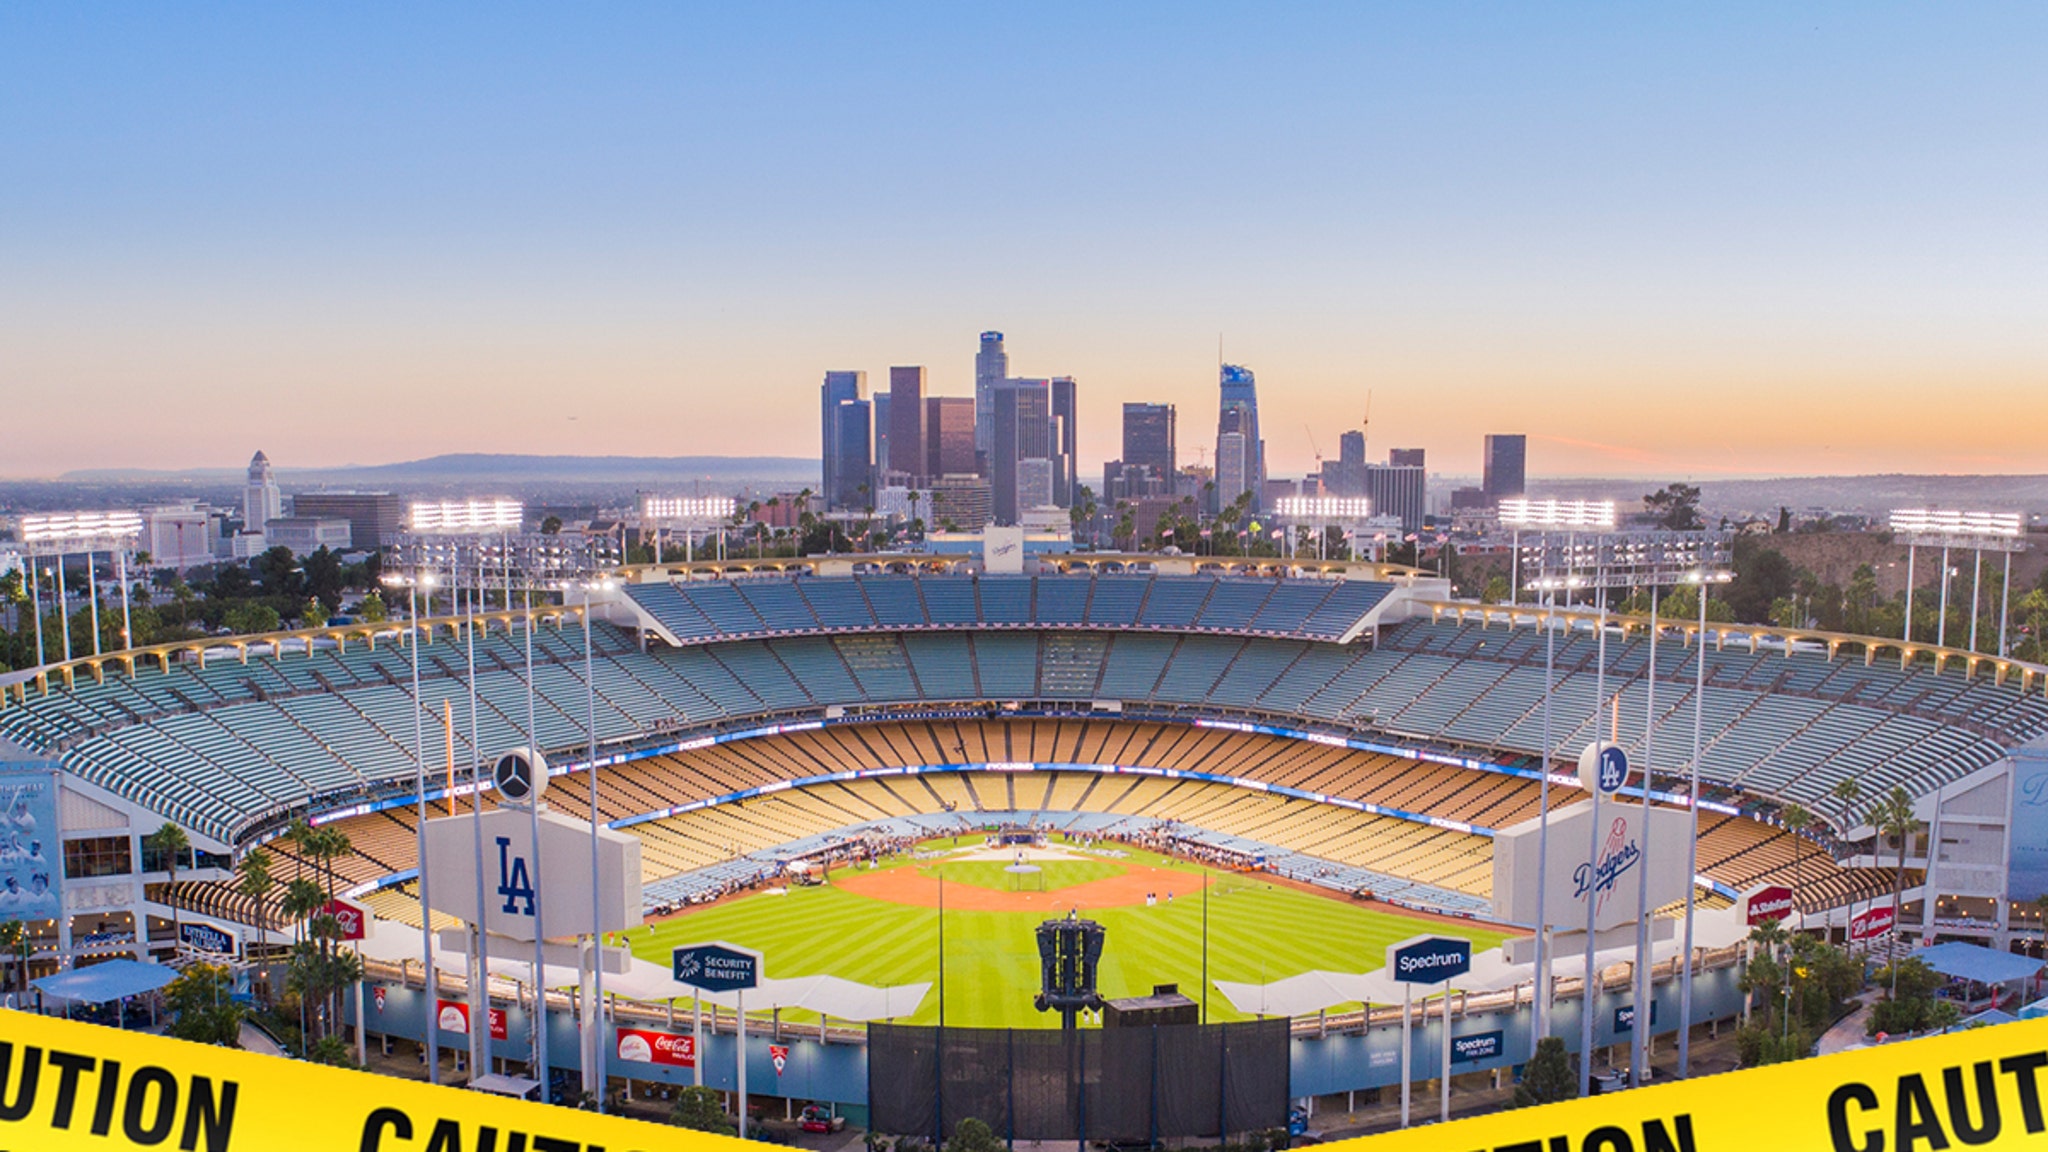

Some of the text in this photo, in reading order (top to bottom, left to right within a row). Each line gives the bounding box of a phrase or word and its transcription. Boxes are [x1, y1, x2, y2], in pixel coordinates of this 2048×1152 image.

[1602, 753, 1620, 788] LA
[496, 836, 535, 916] LA
[704, 955, 752, 970] SECURITY
[1400, 952, 1462, 973] Spectrum
[704, 967, 747, 980] BENEFIT
[1456, 1037, 1496, 1053] Spectrum
